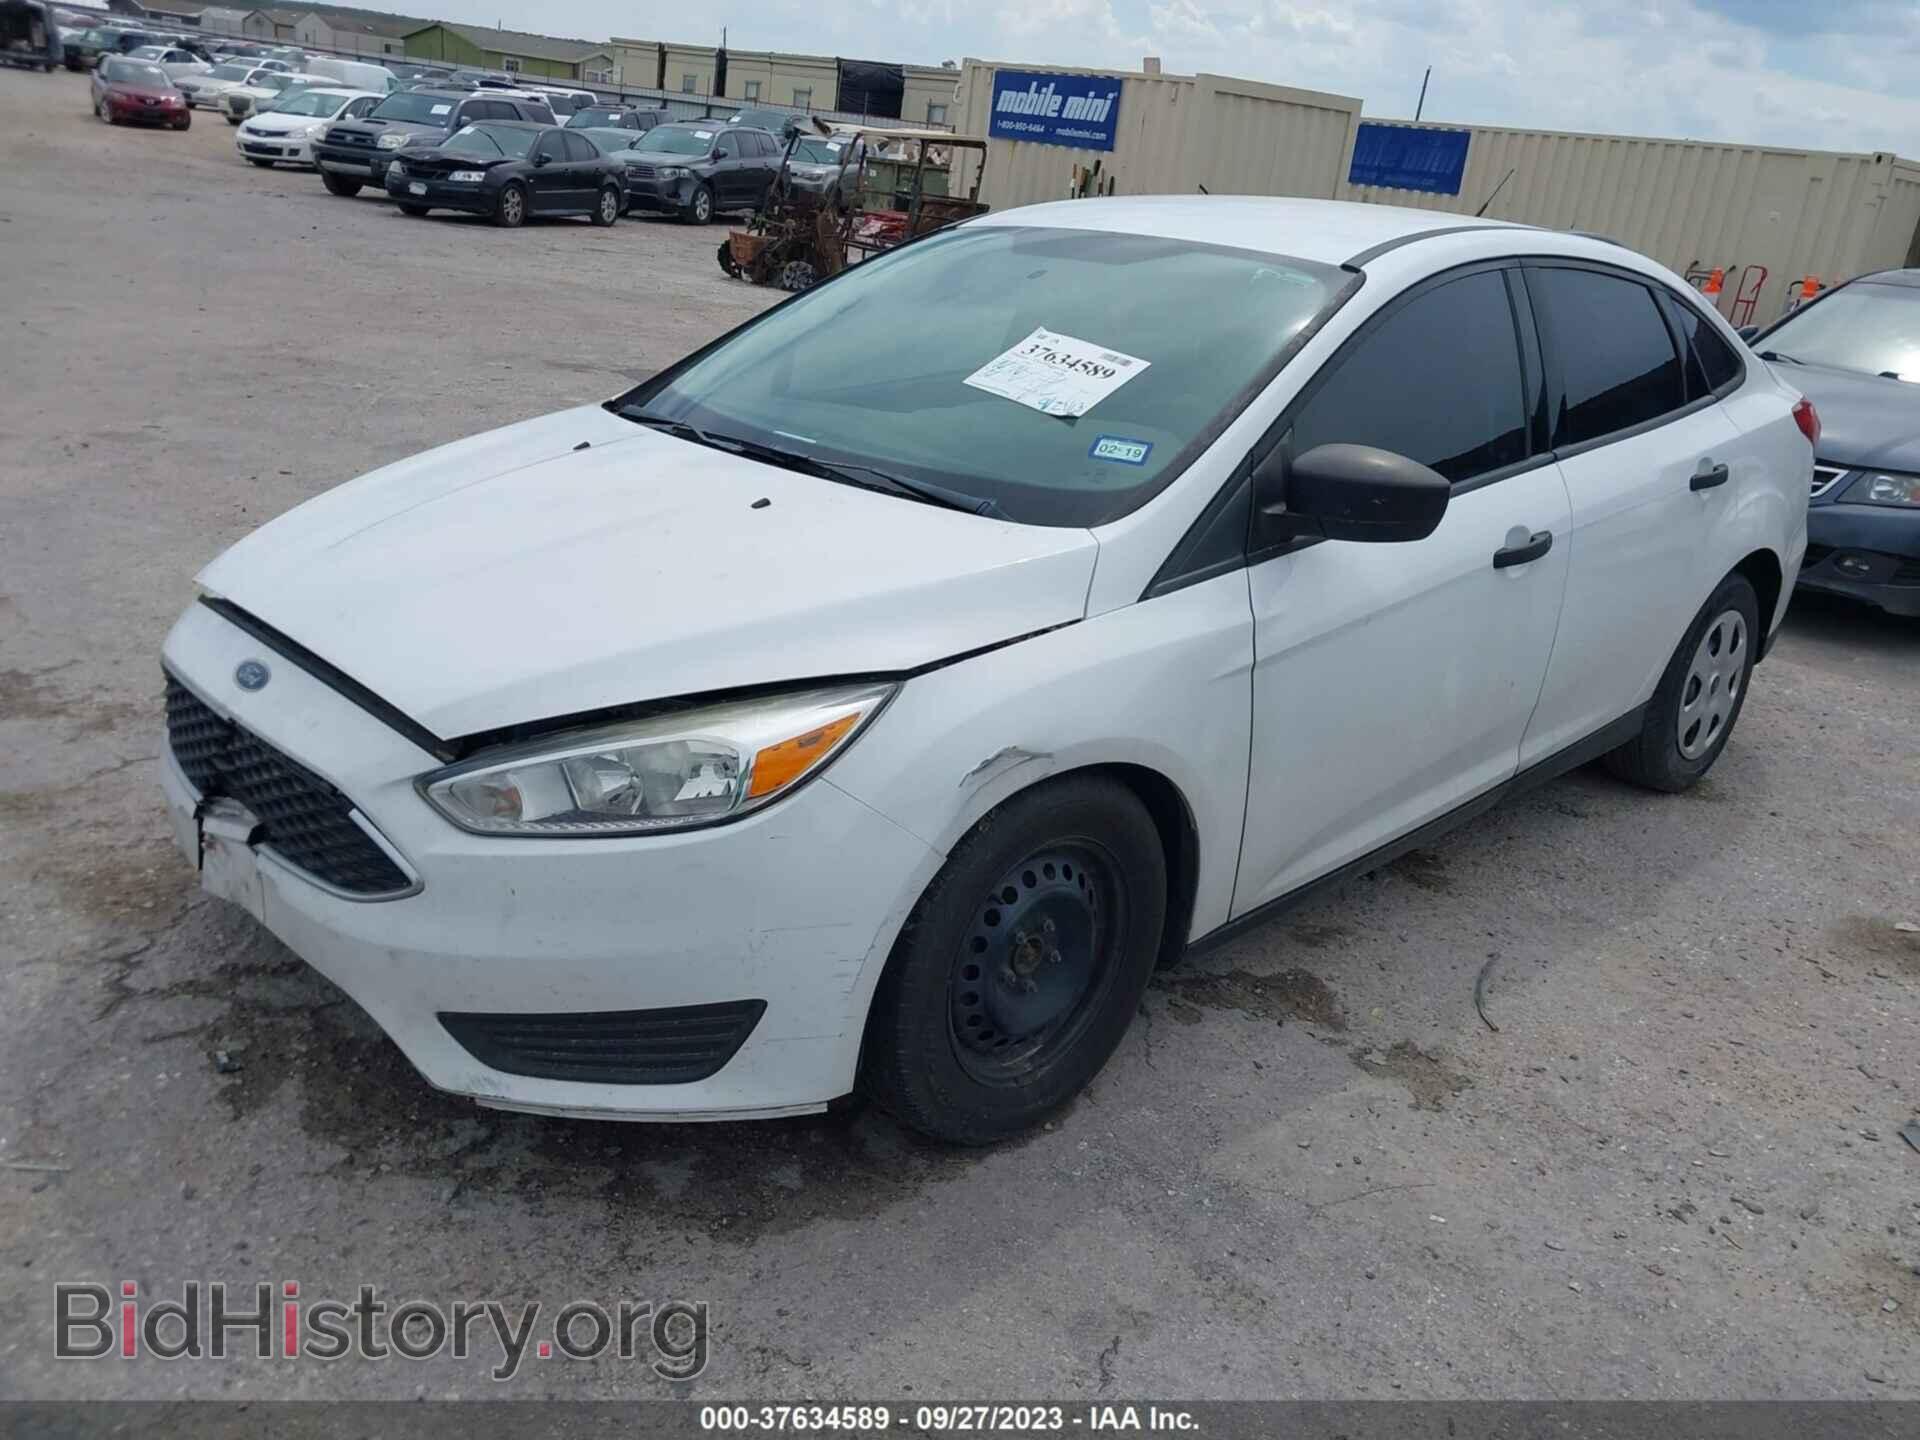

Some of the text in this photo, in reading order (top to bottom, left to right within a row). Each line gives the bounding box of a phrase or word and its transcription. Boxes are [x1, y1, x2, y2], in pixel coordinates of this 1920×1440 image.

[996, 81, 1114, 122] mobile mini
[1021, 344, 1116, 379] 37634589
